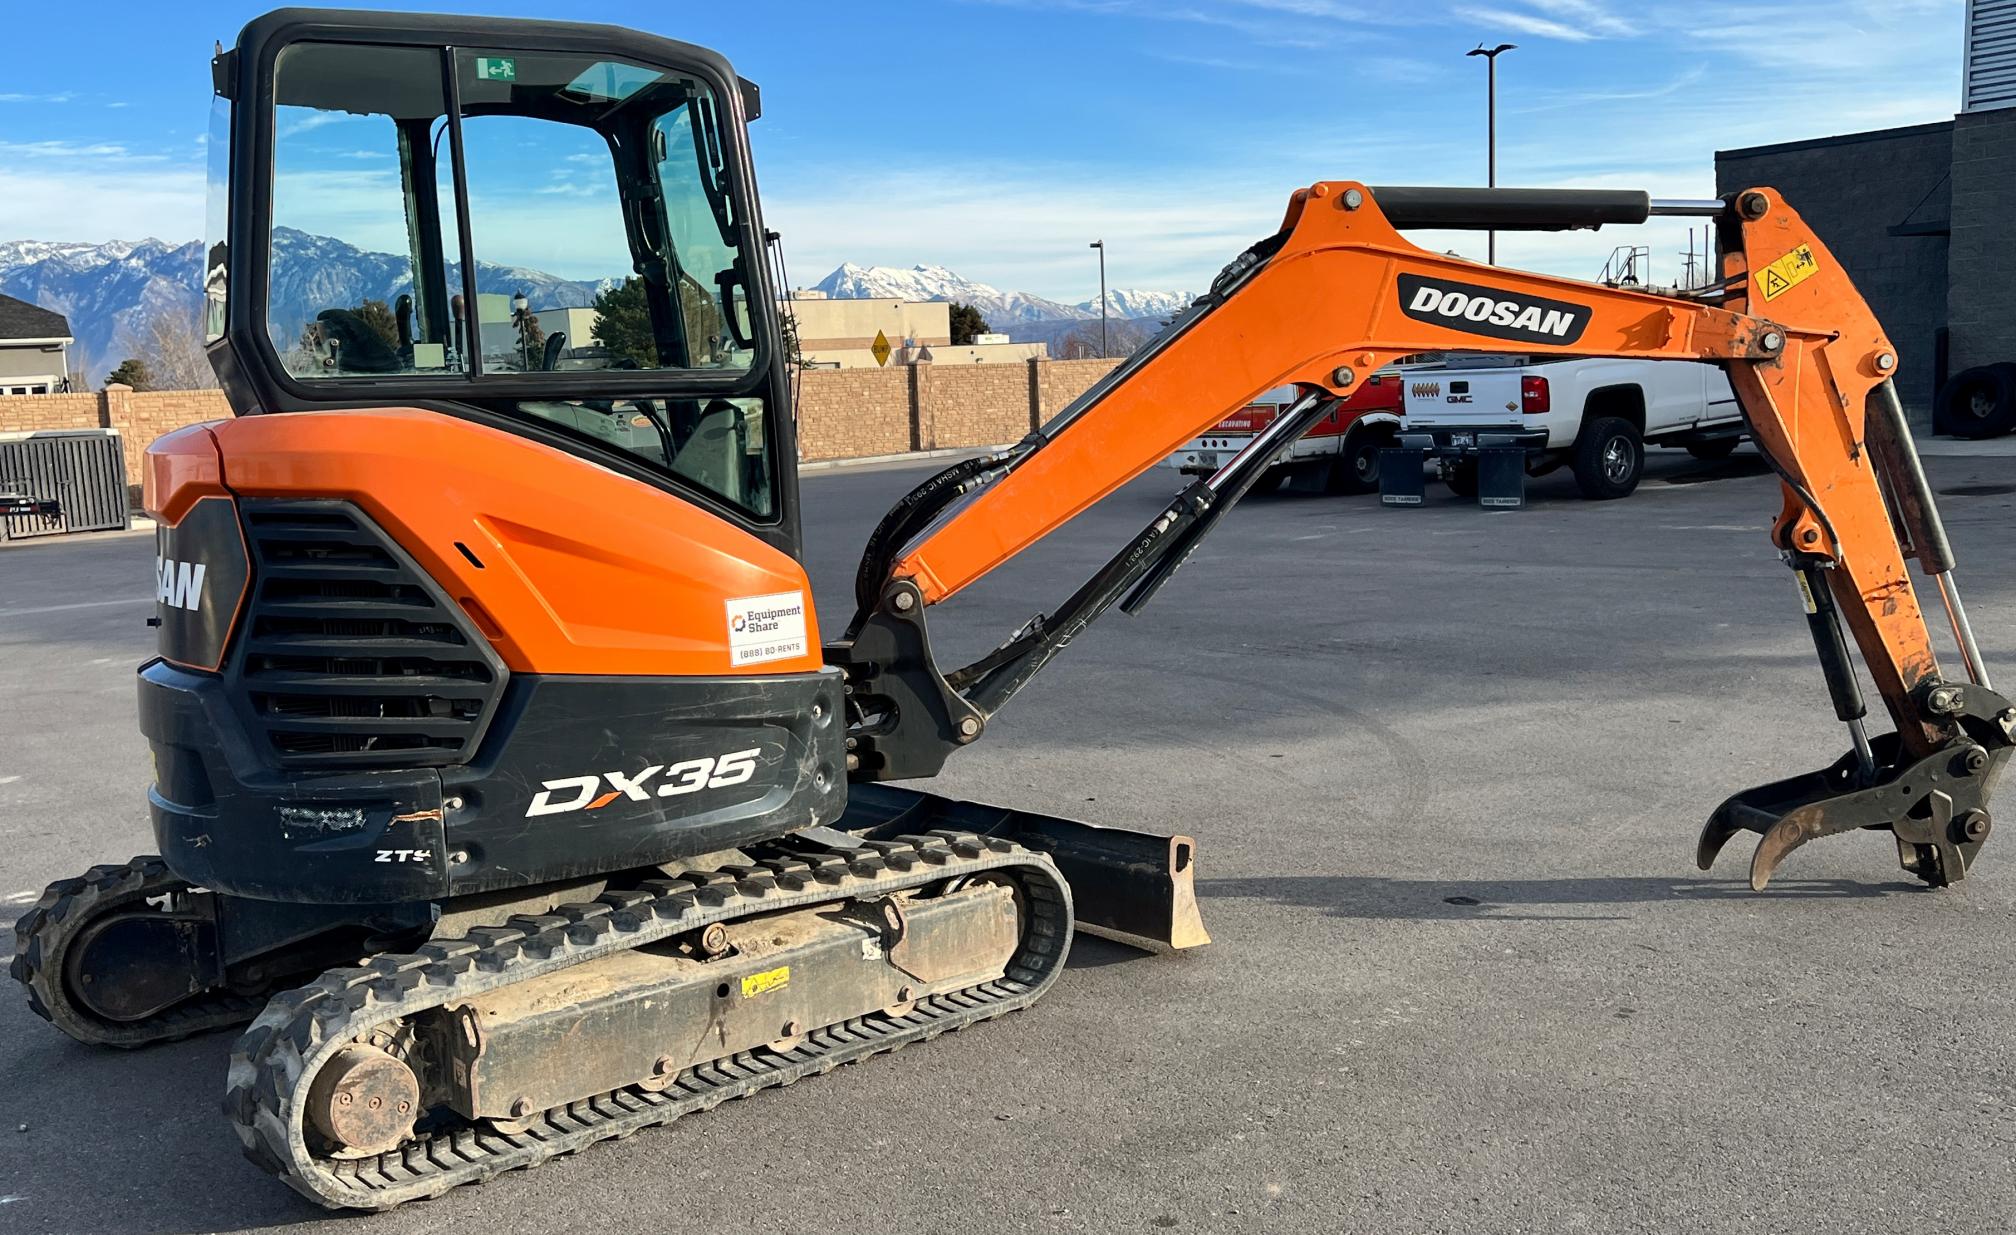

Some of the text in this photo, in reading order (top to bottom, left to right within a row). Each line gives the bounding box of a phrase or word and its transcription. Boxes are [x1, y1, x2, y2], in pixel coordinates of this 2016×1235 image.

[1409, 286, 1575, 337] DOOSAN
[1446, 395, 1473, 404] GMC
[747, 605, 801, 622] Equipment
[748, 621, 779, 633] Share
[740, 648, 763, 659] (888)
[525, 748, 762, 818] DX35
